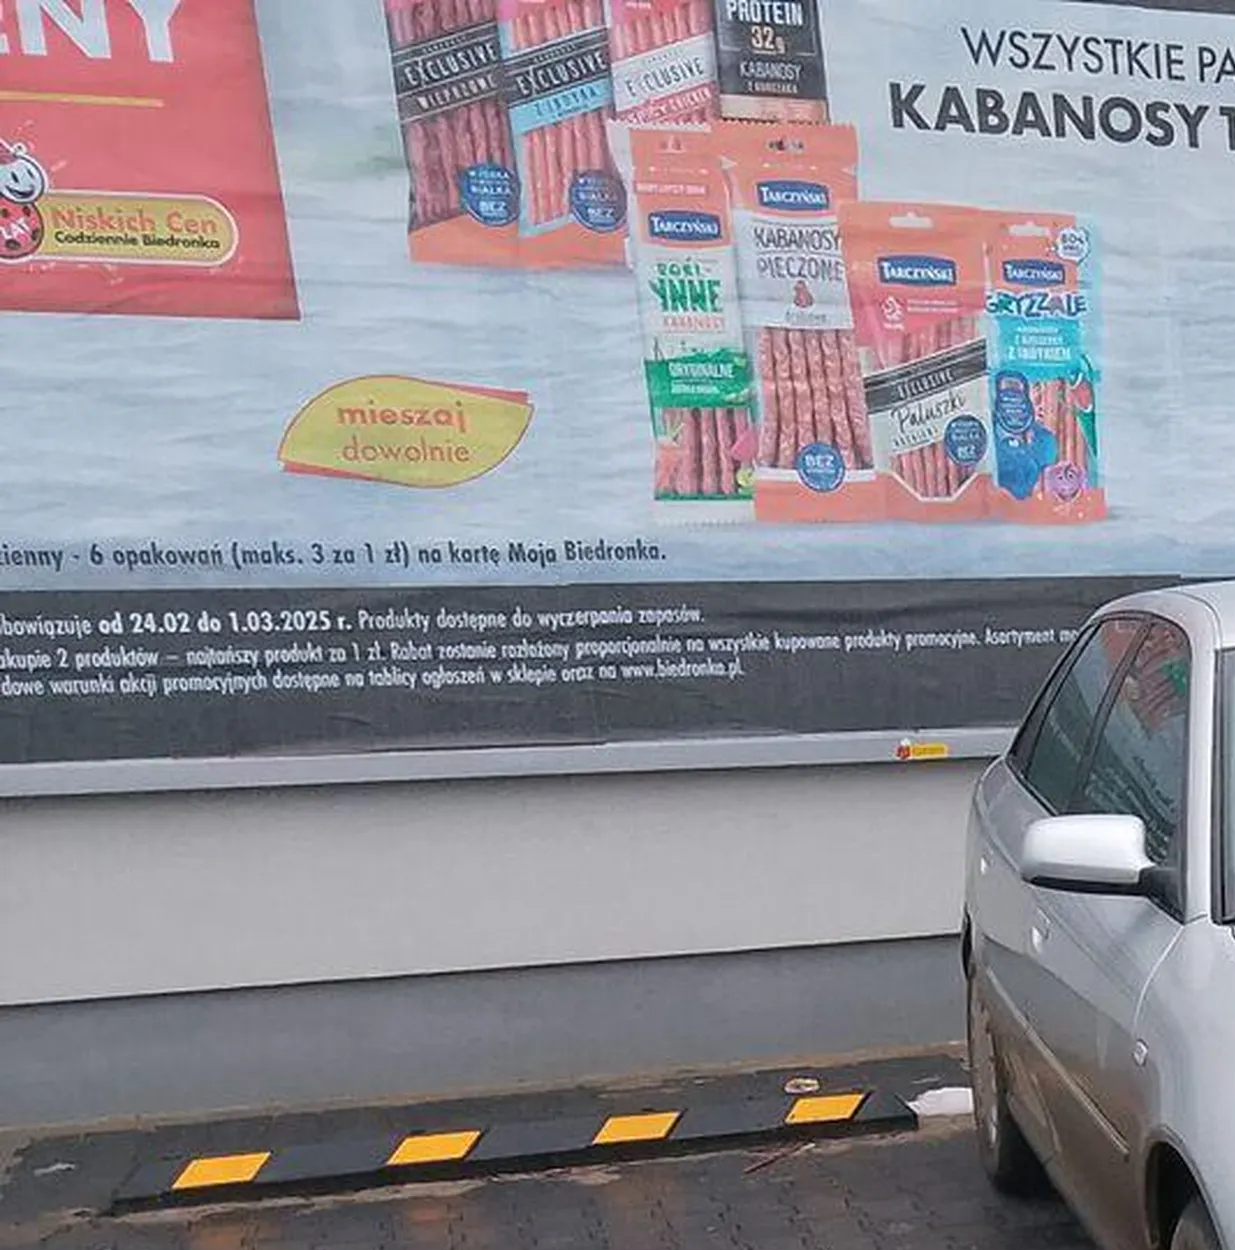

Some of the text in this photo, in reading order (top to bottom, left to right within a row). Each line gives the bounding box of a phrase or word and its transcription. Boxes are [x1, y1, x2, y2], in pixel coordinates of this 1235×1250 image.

[726, 0, 803, 26] PROTEIN
[0, 0, 181, 62] NY
[404, 42, 498, 87] EXCLUSIVE
[961, 27, 1186, 82] WSZYSTKIE
[515, 52, 607, 96] EXCLUSIVE
[740, 61, 802, 80] KABANOSY
[889, 82, 1209, 149] KABANOSY
[54, 206, 218, 234] Niskich Cen
[54, 230, 220, 249] Codziennie Biedronka
[753, 226, 841, 251] KABANOSY
[757, 256, 845, 282] PIECZONE
[337, 400, 467, 433] mieszaj
[341, 434, 471, 462] dowolnie
[803, 453, 834, 467] BEZ
[90, 544, 103, 565] 6
[113, 542, 223, 571] opakowań
[232, 541, 303, 570] (maks.
[312, 543, 325, 565] 3
[333, 549, 355, 564] za
[364, 543, 374, 563] 1
[385, 541, 409, 568] zł)
[418, 549, 442, 563] na
[449, 541, 499, 566] kartę
[508, 543, 557, 568] Moja
[565, 539, 666, 562] Biedronka.
[99, 611, 123, 634] od
[129, 612, 190, 634] 24.02
[198, 611, 221, 632] do
[229, 610, 331, 632] 1.03.2025
[337, 615, 352, 630] r.
[358, 606, 430, 632] Produkty
[437, 607, 507, 632] dostępne
[512, 606, 532, 628] do
[536, 604, 633, 631] wyczerpania
[638, 604, 705, 627] zapasów.
[56, 648, 69, 668] 2
[75, 645, 158, 671] produktów
[265, 641, 323, 667] produkt
[329, 648, 346, 662] za
[352, 642, 359, 661] 1
[390, 640, 432, 660] Rabat
[437, 640, 497, 660] zostanie
[575, 634, 681, 660] proporcjonalnie
[687, 638, 704, 651] na
[708, 631, 770, 654] wszystkie
[844, 629, 900, 652] produkty
[984, 627, 1054, 648] Asortyment
[50, 673, 114, 695] warunki
[272, 667, 340, 692] dostępne
[345, 673, 364, 687] na
[369, 665, 417, 690] tablicy
[422, 664, 485, 690] ogłoszeń
[489, 674, 501, 685] w
[507, 662, 556, 687] sklepie
[561, 667, 594, 682] oraz
[599, 664, 616, 679] na
